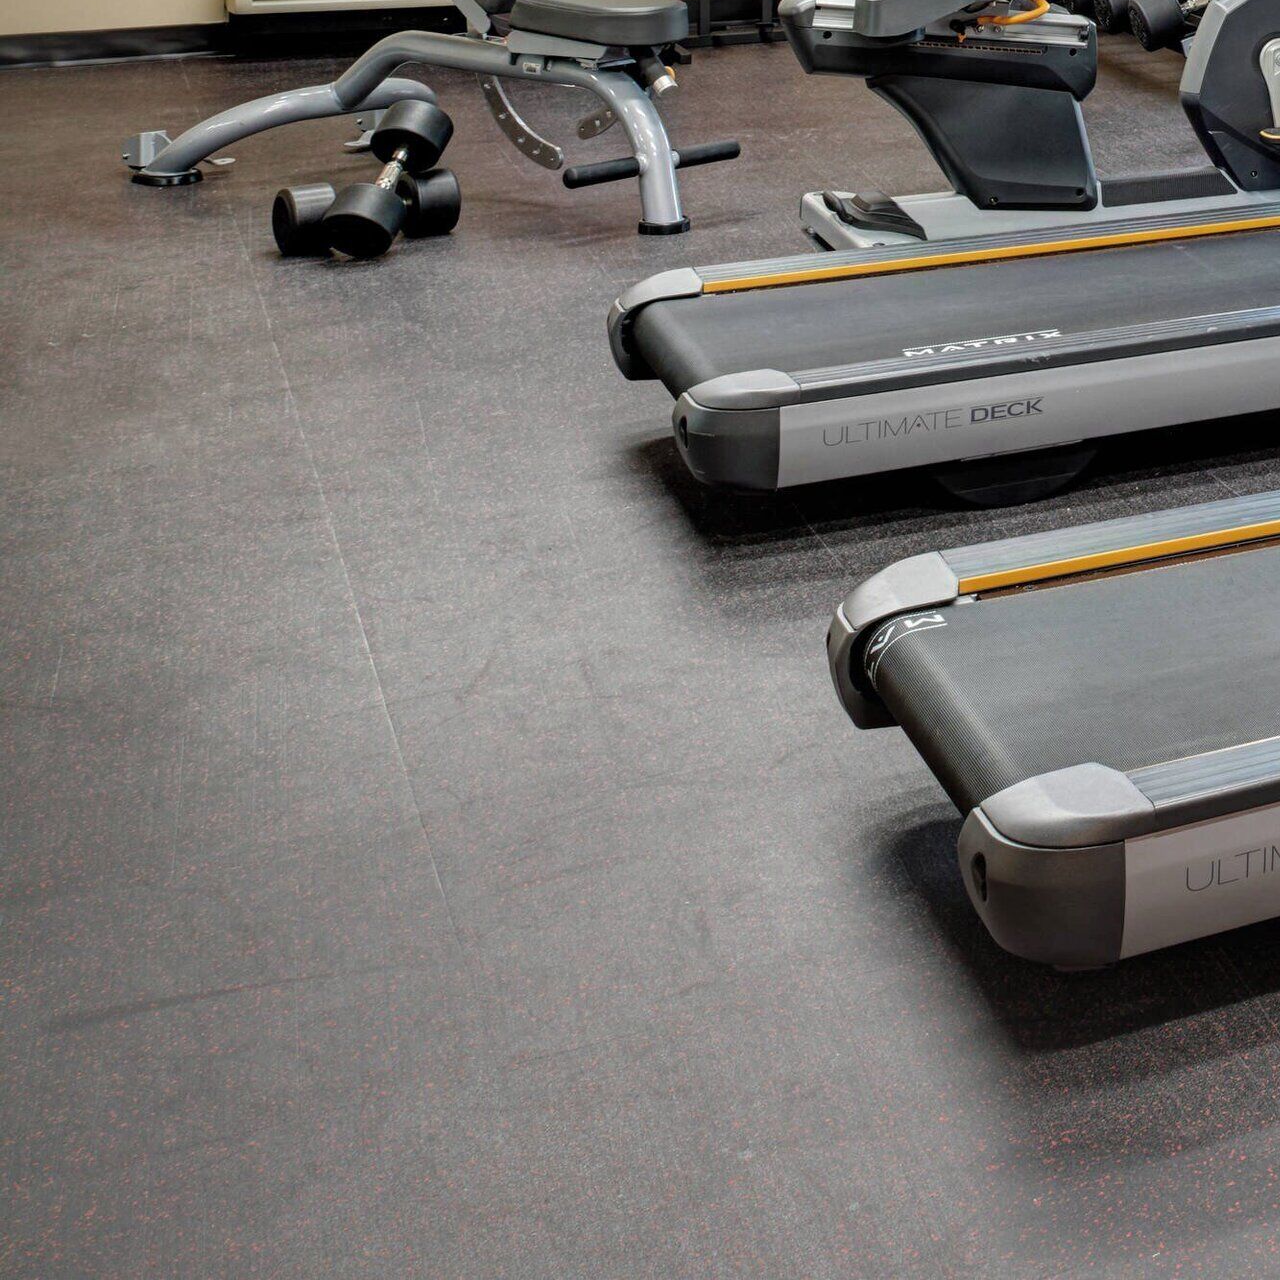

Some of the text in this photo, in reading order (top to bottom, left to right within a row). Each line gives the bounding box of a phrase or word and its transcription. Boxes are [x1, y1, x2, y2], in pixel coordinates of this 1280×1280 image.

[904, 331, 1062, 357] MATRIX
[822, 398, 1044, 447] ULTIMATE DECK
